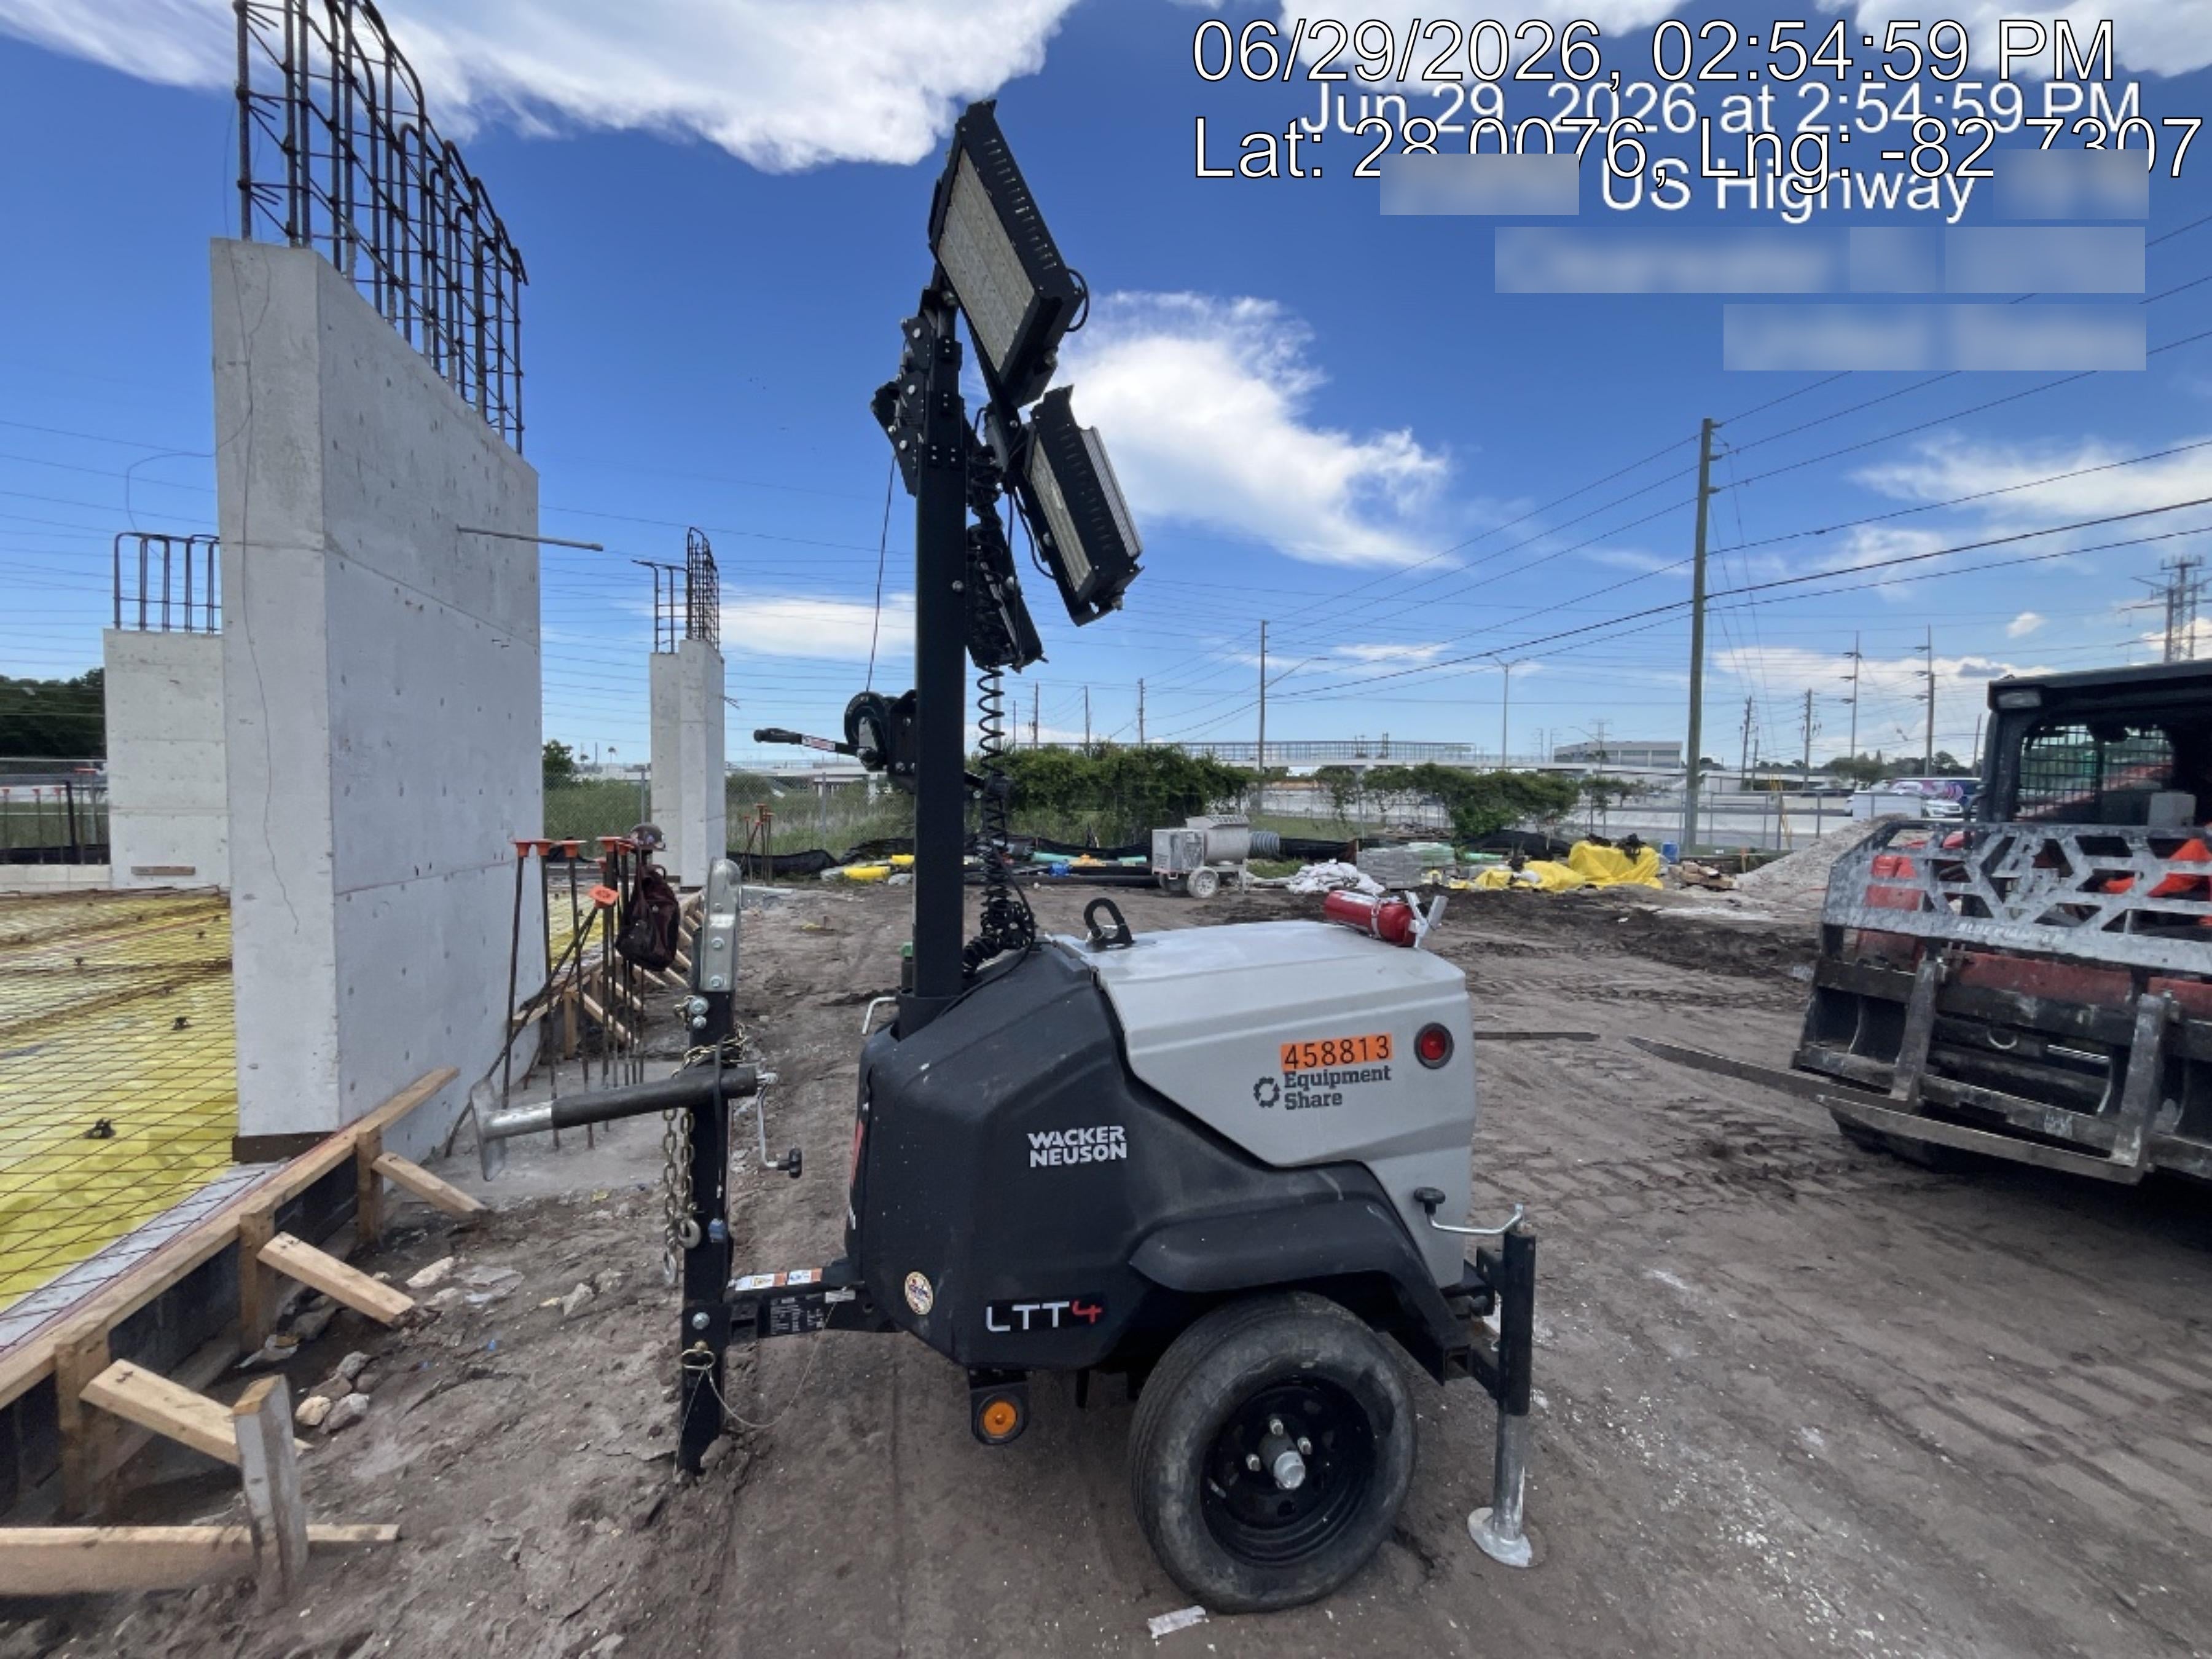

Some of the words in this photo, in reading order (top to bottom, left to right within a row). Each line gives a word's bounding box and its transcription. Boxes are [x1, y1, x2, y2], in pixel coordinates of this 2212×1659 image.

[1284, 1035, 1389, 1070] 458813
[1284, 1065, 1392, 1091] Equipment
[1284, 1091, 1343, 1110] Share
[1027, 1126, 1126, 1149] WACKER
[1030, 1142, 1128, 1167] NEUSON
[986, 1300, 1102, 1332] LTT4
